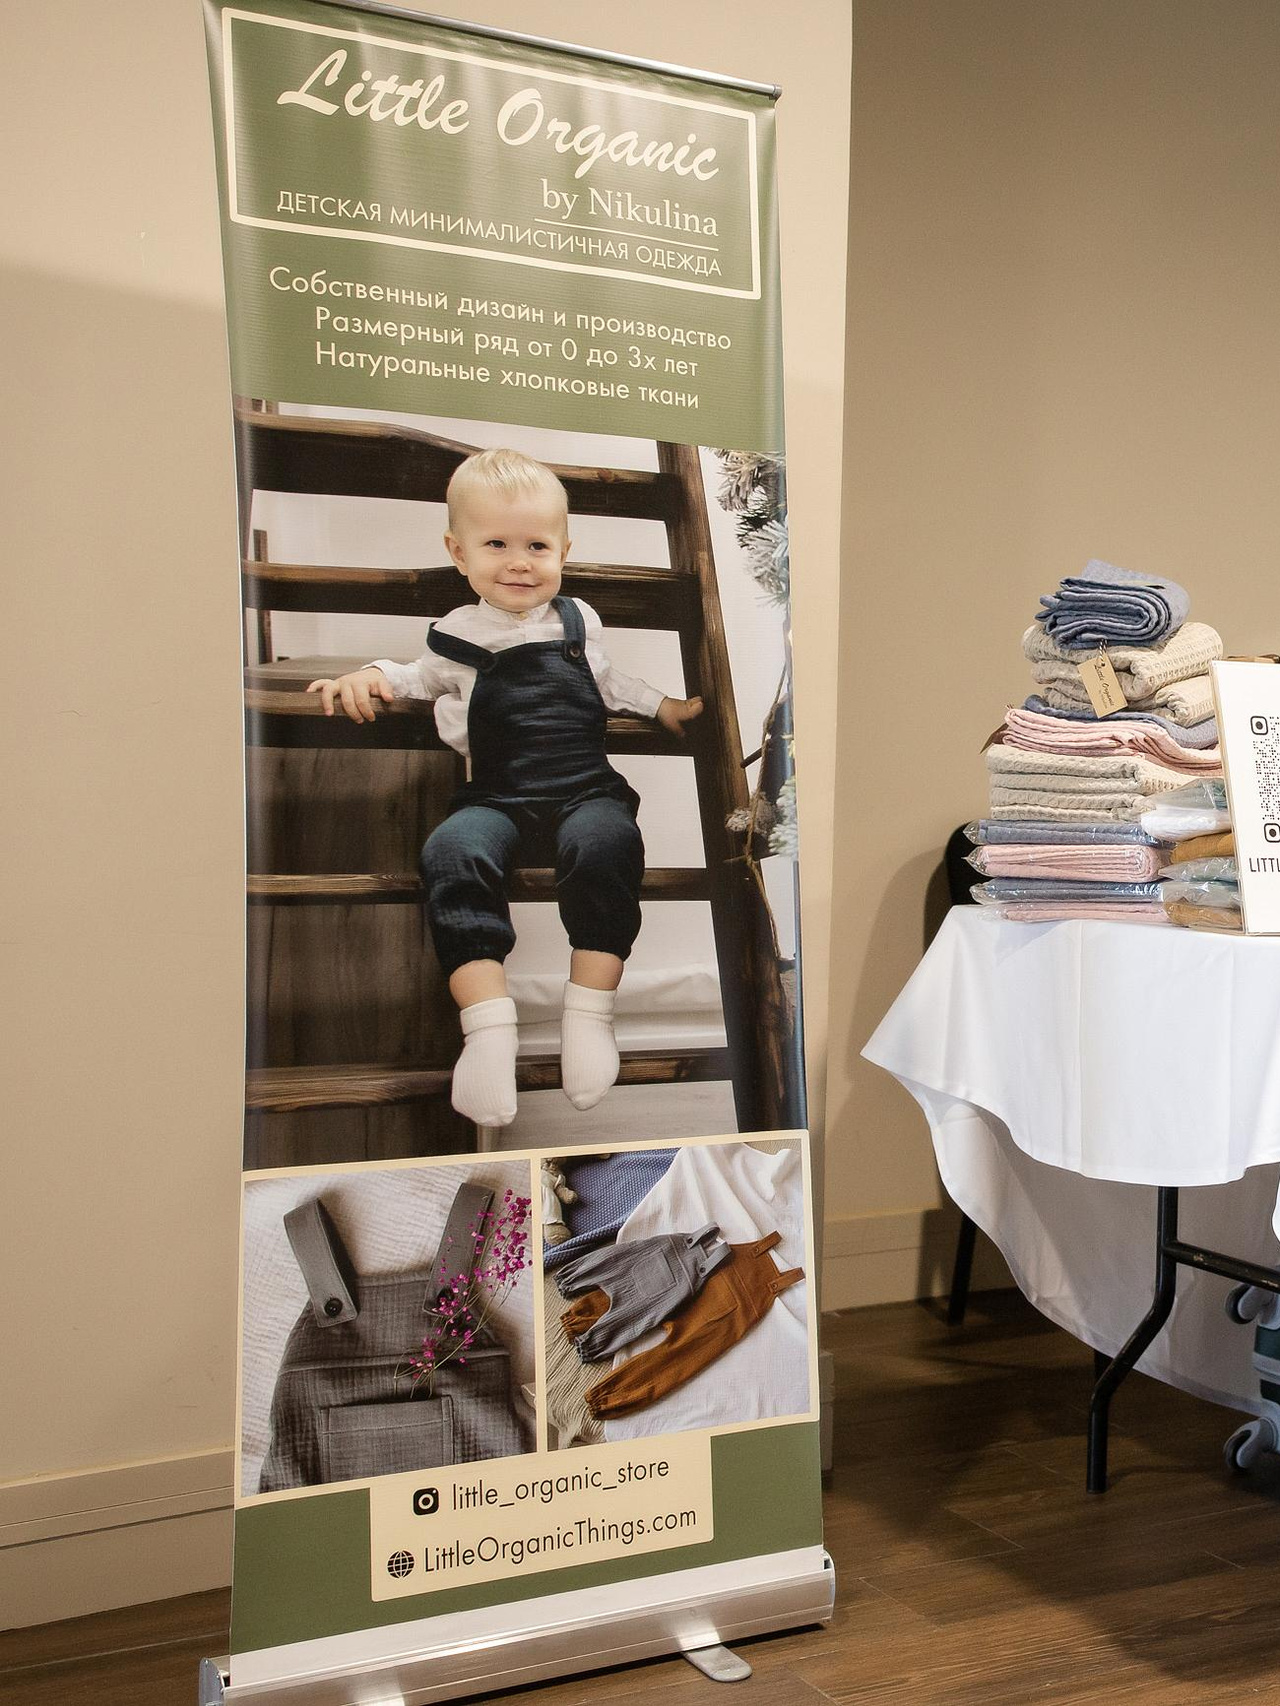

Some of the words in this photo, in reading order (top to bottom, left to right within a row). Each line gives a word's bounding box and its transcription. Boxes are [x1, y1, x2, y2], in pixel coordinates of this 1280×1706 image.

[276, 49, 470, 135] Little
[496, 88, 719, 182] Organic
[277, 190, 382, 223] ДЕТСКАЯ
[389, 209, 629, 261] МИНИМАЛИСТИЧНАЯ
[635, 245, 722, 277] ОДЕЖДА
[540, 178, 579, 220] by
[588, 187, 719, 237] Nikulina
[269, 266, 448, 310] Собственный
[457, 297, 544, 324] дизайн
[553, 311, 566, 327] и
[576, 313, 732, 350] производство
[315, 305, 464, 346] Размерный
[474, 332, 520, 358] ряд
[527, 341, 553, 357] от
[561, 338, 577, 361] 0
[586, 349, 618, 367] до
[664, 358, 698, 377] лет
[315, 341, 491, 383] Натуральные
[500, 369, 630, 399] хлопковые
[638, 386, 699, 409] ткани
[452, 1460, 670, 1511] little_organic_store
[425, 1509, 697, 1573] LittleOrganicThings.com
